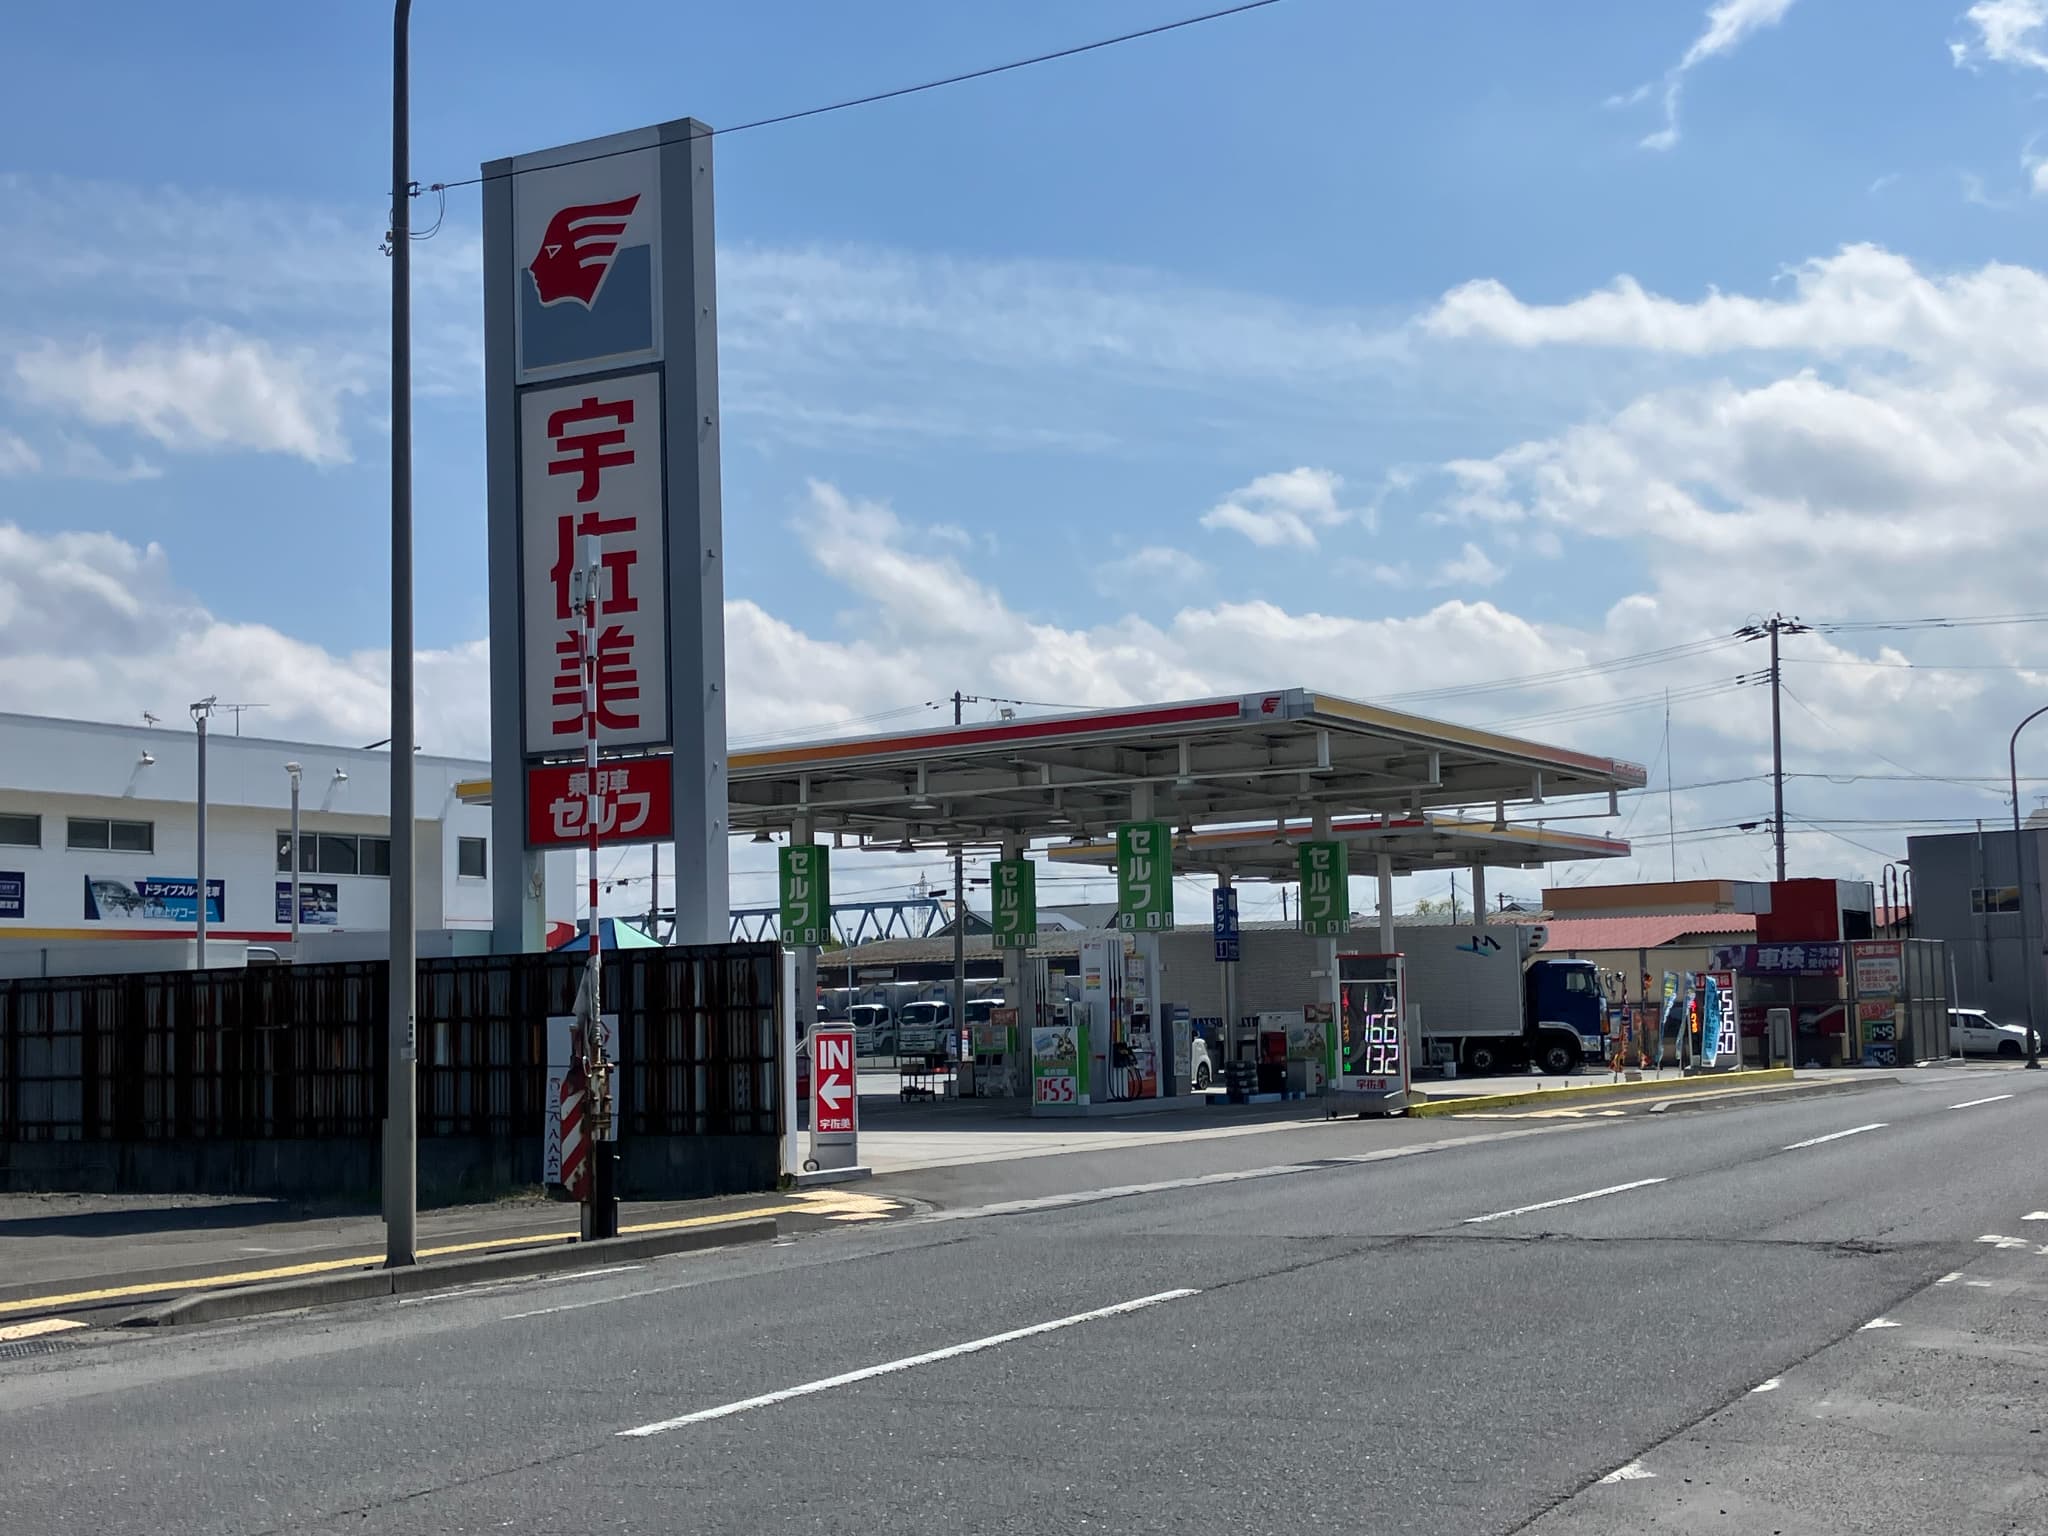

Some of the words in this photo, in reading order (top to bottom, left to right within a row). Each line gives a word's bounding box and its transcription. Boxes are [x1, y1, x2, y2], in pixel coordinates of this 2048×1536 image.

[547, 397, 640, 734] 宇佐美
[568, 769, 629, 797] 乗用車
[549, 791, 650, 837] セルフ
[788, 850, 809, 926] セルフ
[1128, 828, 1151, 910] セルフ
[1308, 847, 1331, 918] セルフ
[999, 864, 1019, 932] セルフ
[1757, 947, 1805, 970] 車検
[1364, 1013, 1397, 1043] 166
[820, 1040, 850, 1070] IN
[1365, 1044, 1399, 1074] 132
[820, 1119, 851, 1130] 宇佐美
